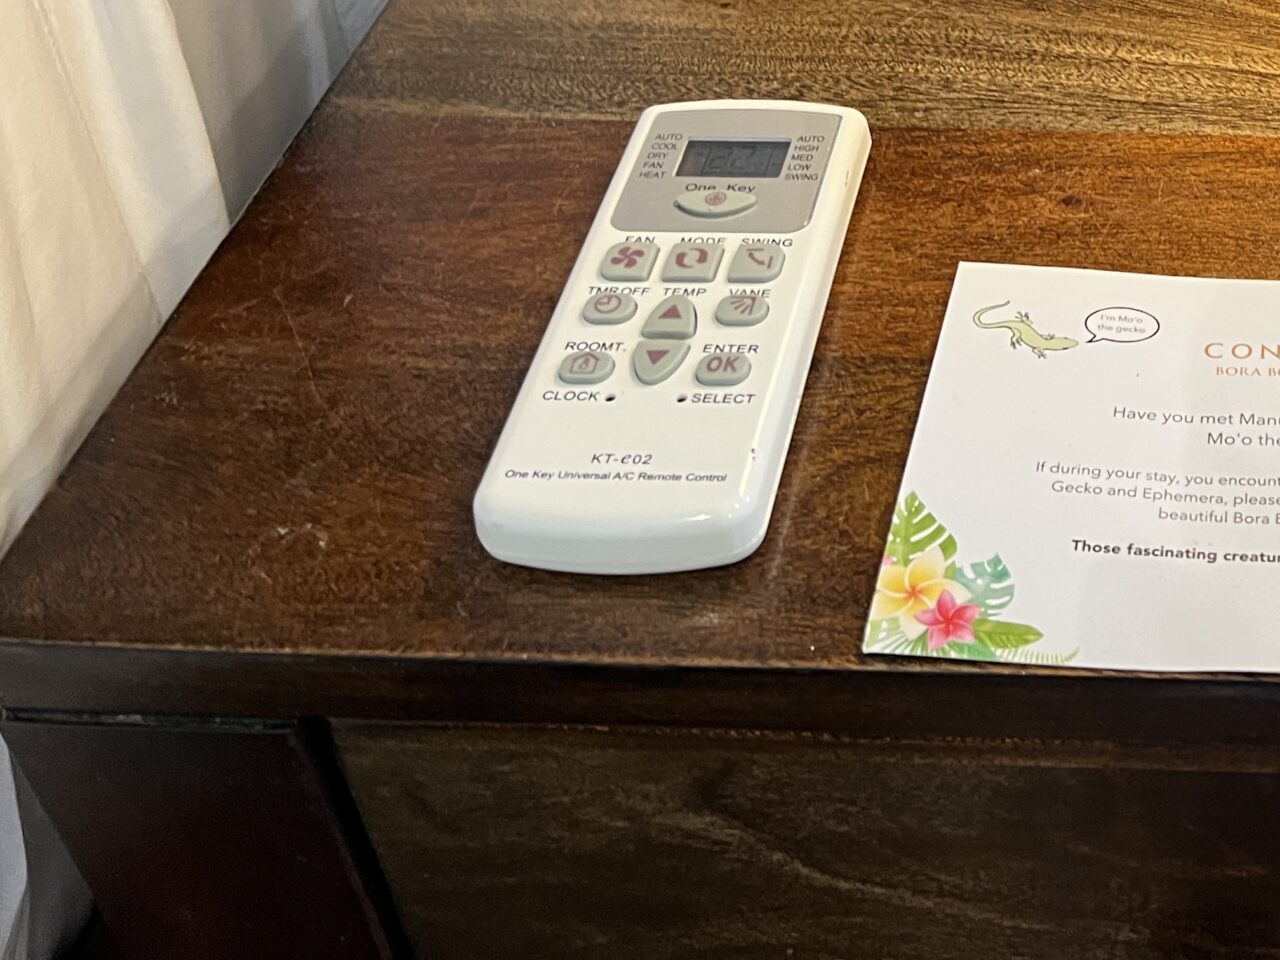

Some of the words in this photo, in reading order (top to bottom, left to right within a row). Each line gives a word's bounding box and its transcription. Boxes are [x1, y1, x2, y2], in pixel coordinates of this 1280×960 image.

[785, 173, 818, 181] SWING
[685, 183, 716, 191] One
[727, 184, 756, 193] Key
[742, 238, 793, 247] SWING
[663, 288, 707, 296] TEMP
[729, 289, 771, 298] VANE
[703, 344, 759, 354] ENTER
[707, 356, 739, 371] OK
[1216, 367, 1260, 377] BORA
[543, 391, 600, 401] CLOCK
[692, 394, 755, 403] SELECT
[1113, 406, 1157, 422] Have
[1162, 412, 1194, 424] you
[1200, 414, 1234, 426] met
[1208, 432, 1252, 446] Mo'o
[505, 470, 529, 479] One
[533, 470, 555, 481] Key
[558, 471, 611, 481] Universal
[613, 472, 634, 481] A/C
[638, 472, 682, 482] Remote
[686, 473, 727, 482] Control
[1036, 462, 1045, 472] If
[1050, 462, 1101, 478] during
[1106, 468, 1140, 479] your
[1146, 471, 1180, 485] stay,
[1185, 475, 1213, 486] you
[1051, 481, 1103, 495] Gecko
[1107, 485, 1136, 497] and
[1142, 488, 1227, 505] Ephemera,
[1158, 508, 1227, 523] beautiful
[1233, 512, 1270, 524] Bora
[1072, 540, 1120, 554] Those
[1127, 544, 1217, 563] fascinating
